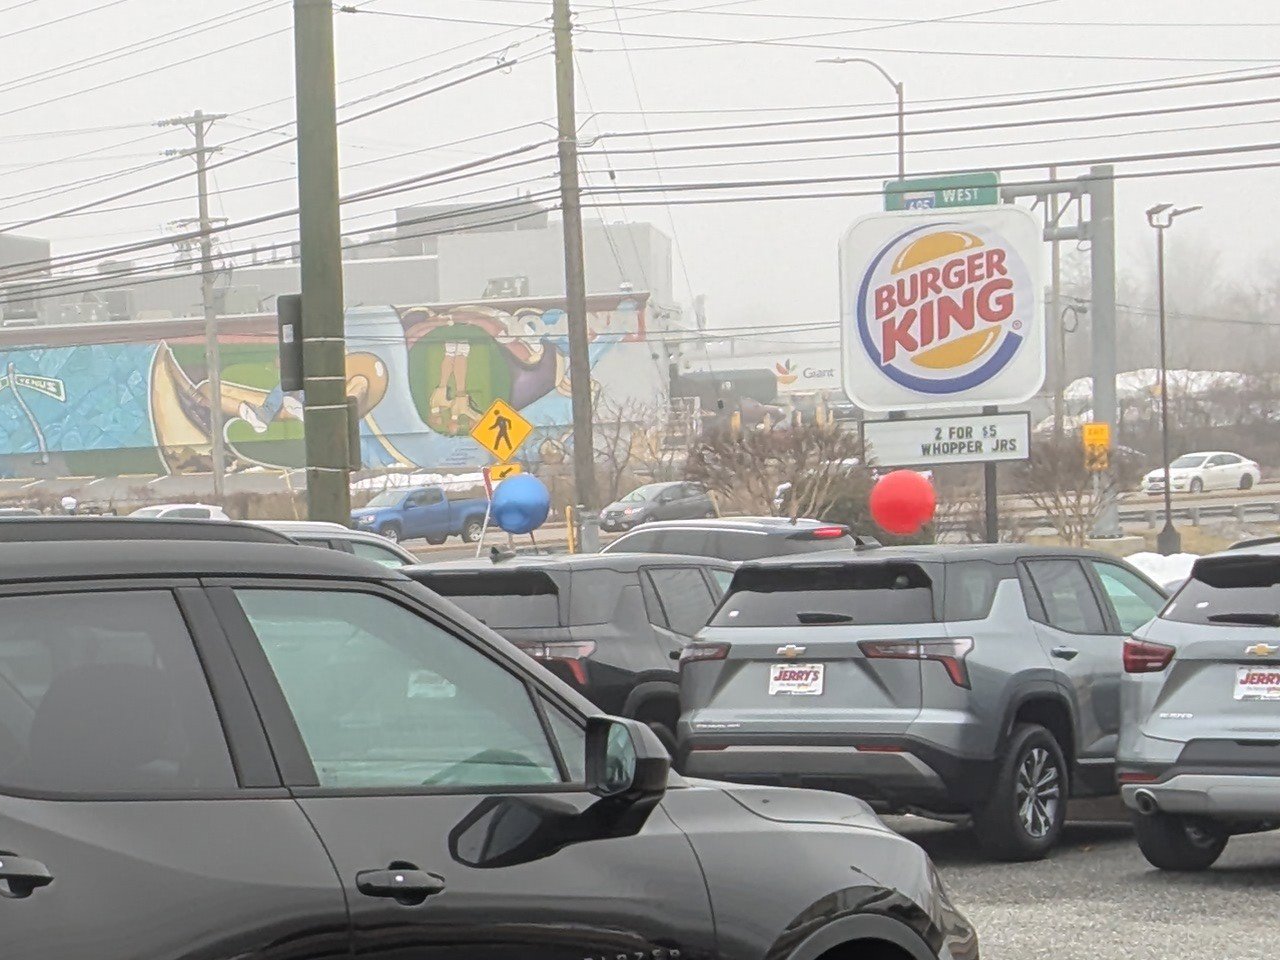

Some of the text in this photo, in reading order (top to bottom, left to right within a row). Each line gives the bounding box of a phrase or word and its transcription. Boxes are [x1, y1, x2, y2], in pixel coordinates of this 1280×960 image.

[943, 188, 979, 202] WEST
[874, 249, 1008, 320] BURGER
[882, 278, 1015, 363] KING
[803, 367, 837, 379] Giant
[934, 424, 997, 440] 2 FOR $5
[921, 439, 1017, 456] WHOPPER JRS
